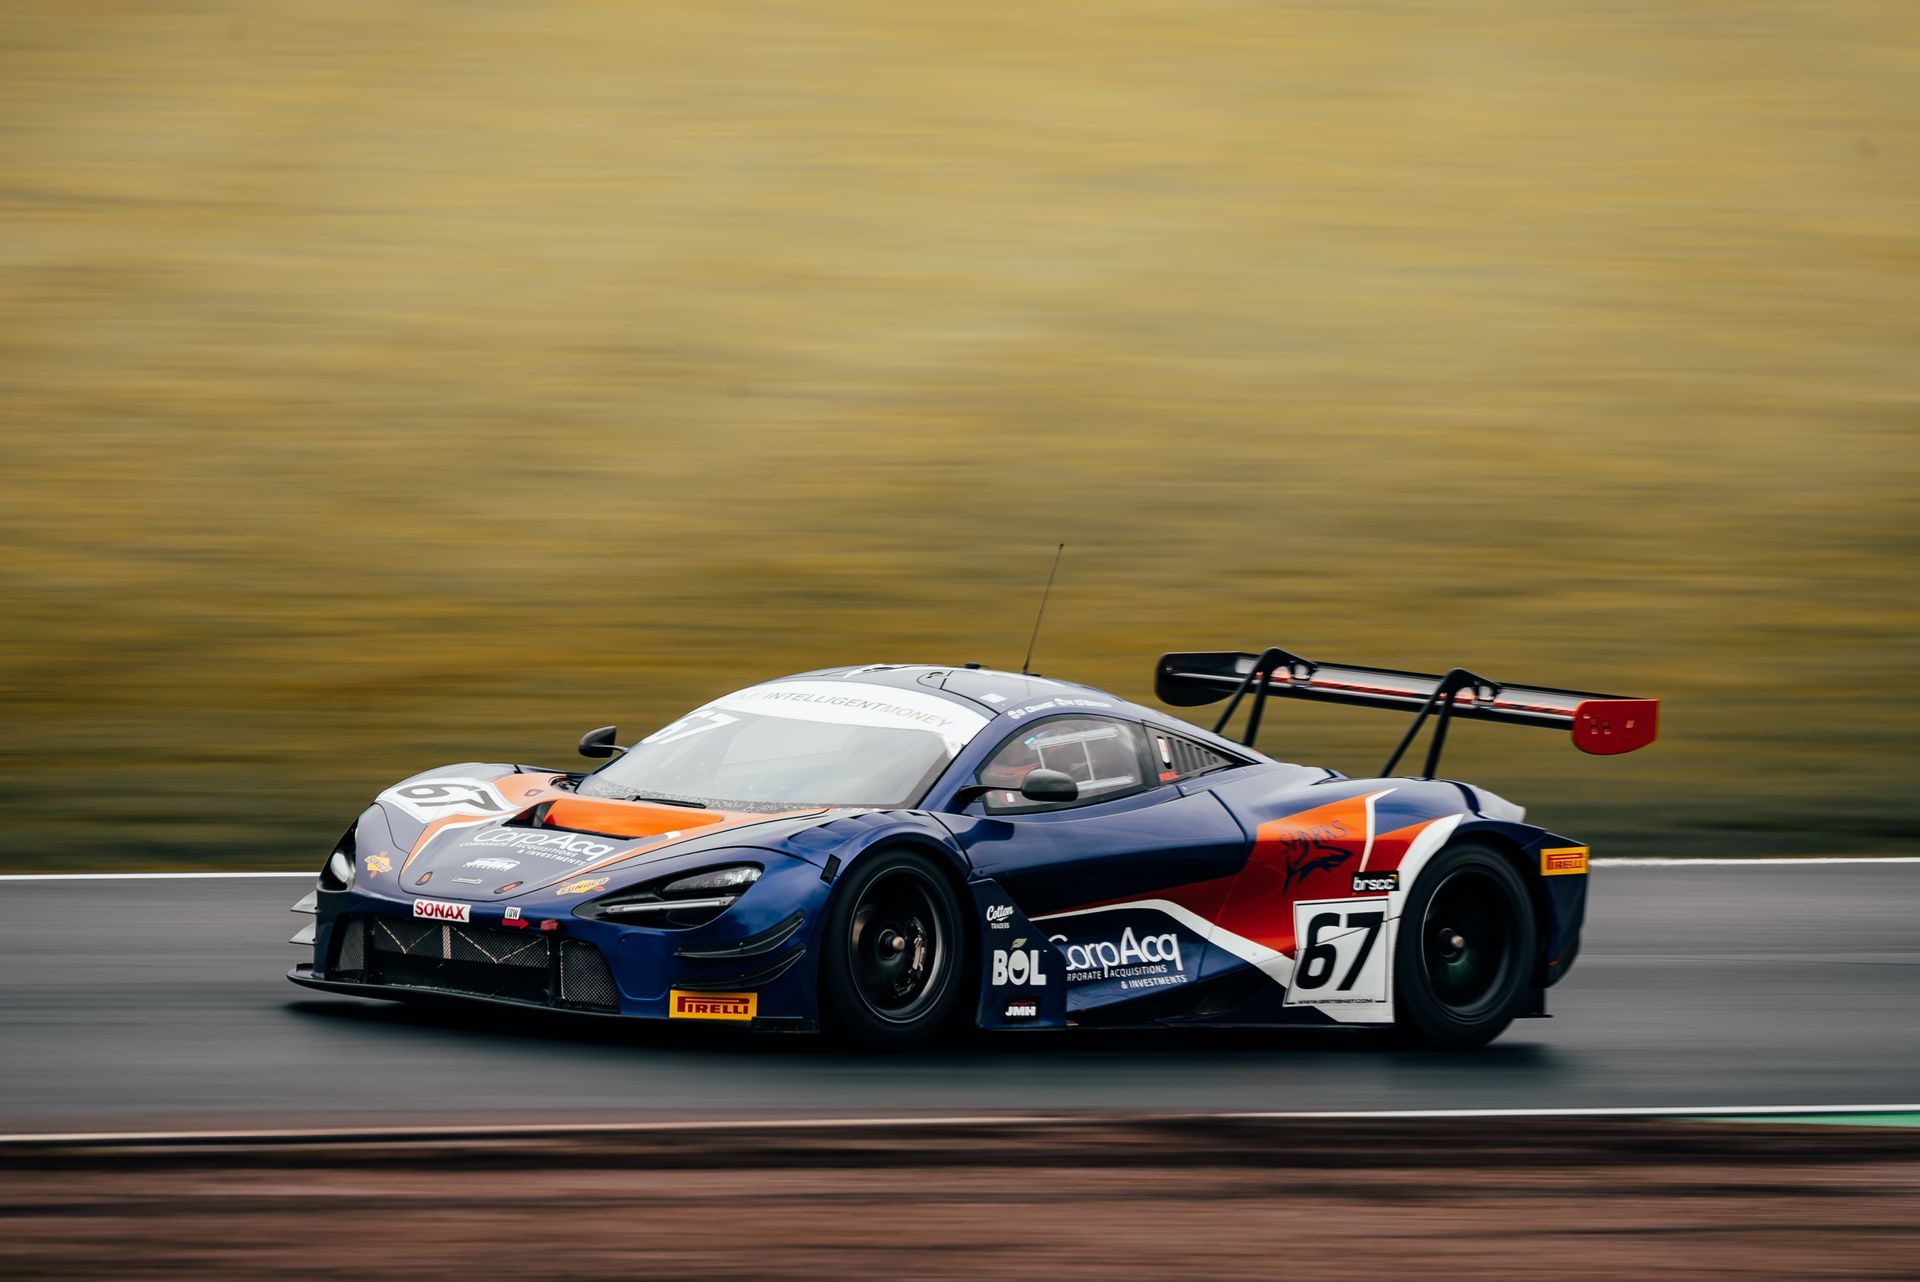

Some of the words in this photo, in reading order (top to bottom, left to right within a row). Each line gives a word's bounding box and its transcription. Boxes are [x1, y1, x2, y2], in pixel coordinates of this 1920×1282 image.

[473, 827, 615, 861] CorpAcq
[1353, 876, 1396, 892] brscc
[414, 901, 466, 921] SONAX
[1295, 911, 1385, 991] 67
[1066, 969, 1102, 982] RPORATE
[1109, 964, 1168, 978] ACQUISITIONS
[1129, 974, 1188, 989] INVESTMENTS
[677, 994, 750, 1015] PIRELLI
